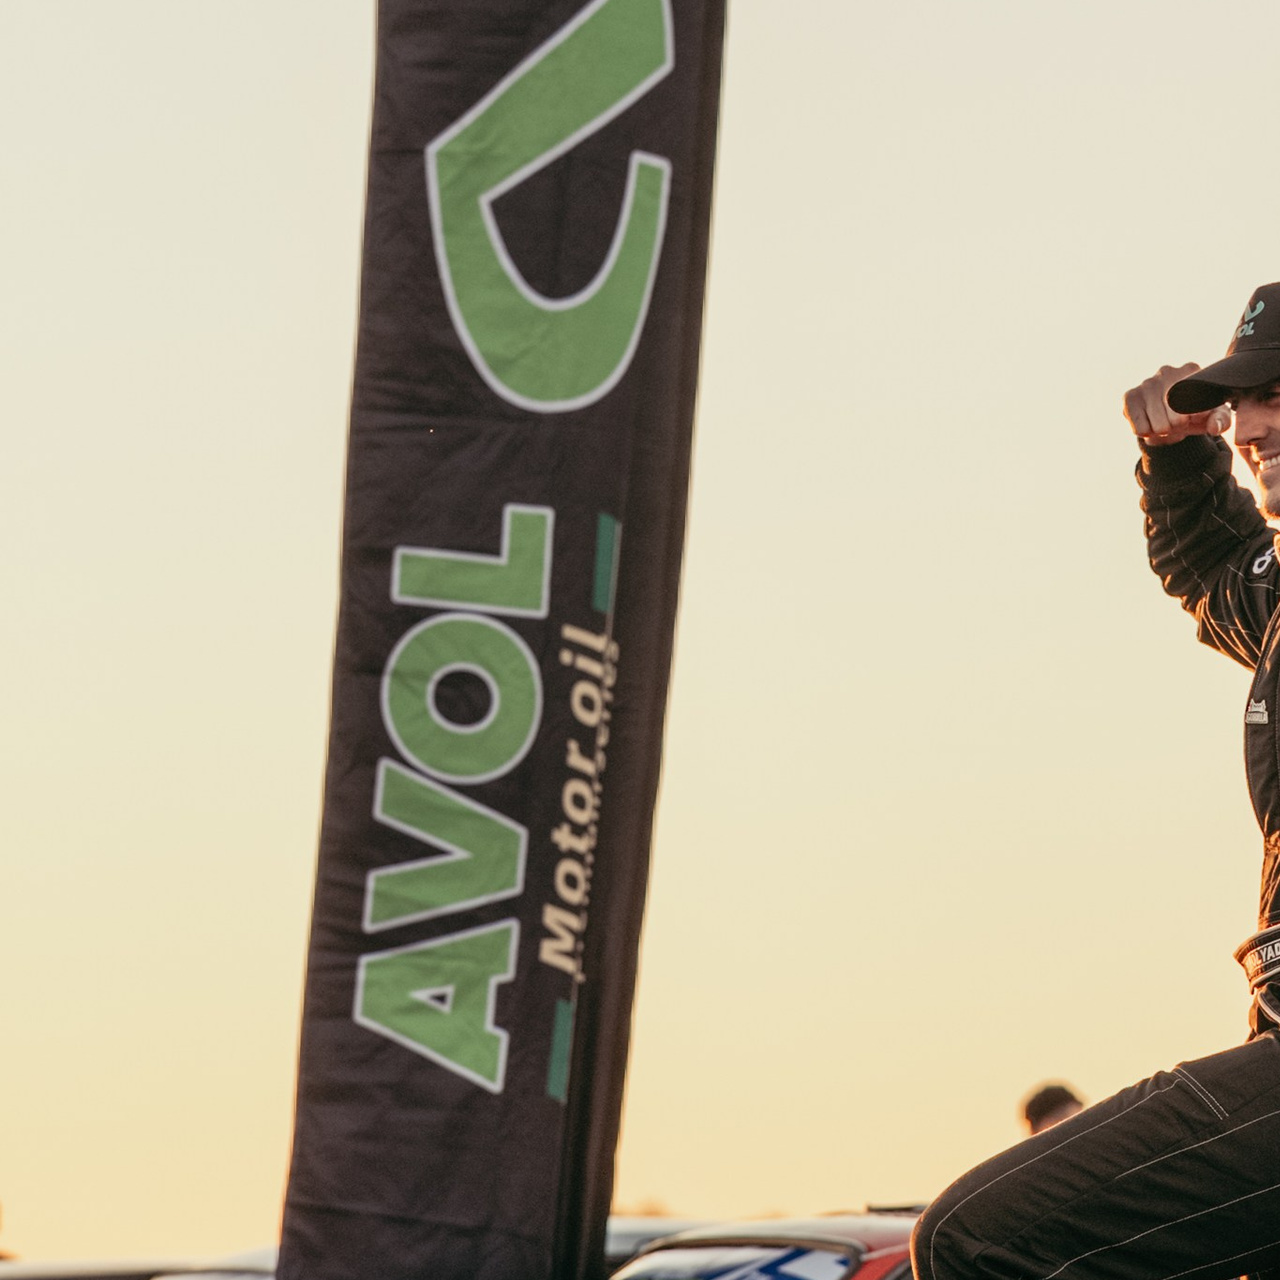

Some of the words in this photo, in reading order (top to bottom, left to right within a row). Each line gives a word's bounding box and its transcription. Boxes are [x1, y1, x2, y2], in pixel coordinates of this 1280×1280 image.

[559, 622, 609, 728] oil
[353, 503, 554, 1094] AVOL
[537, 738, 600, 975] Motor
